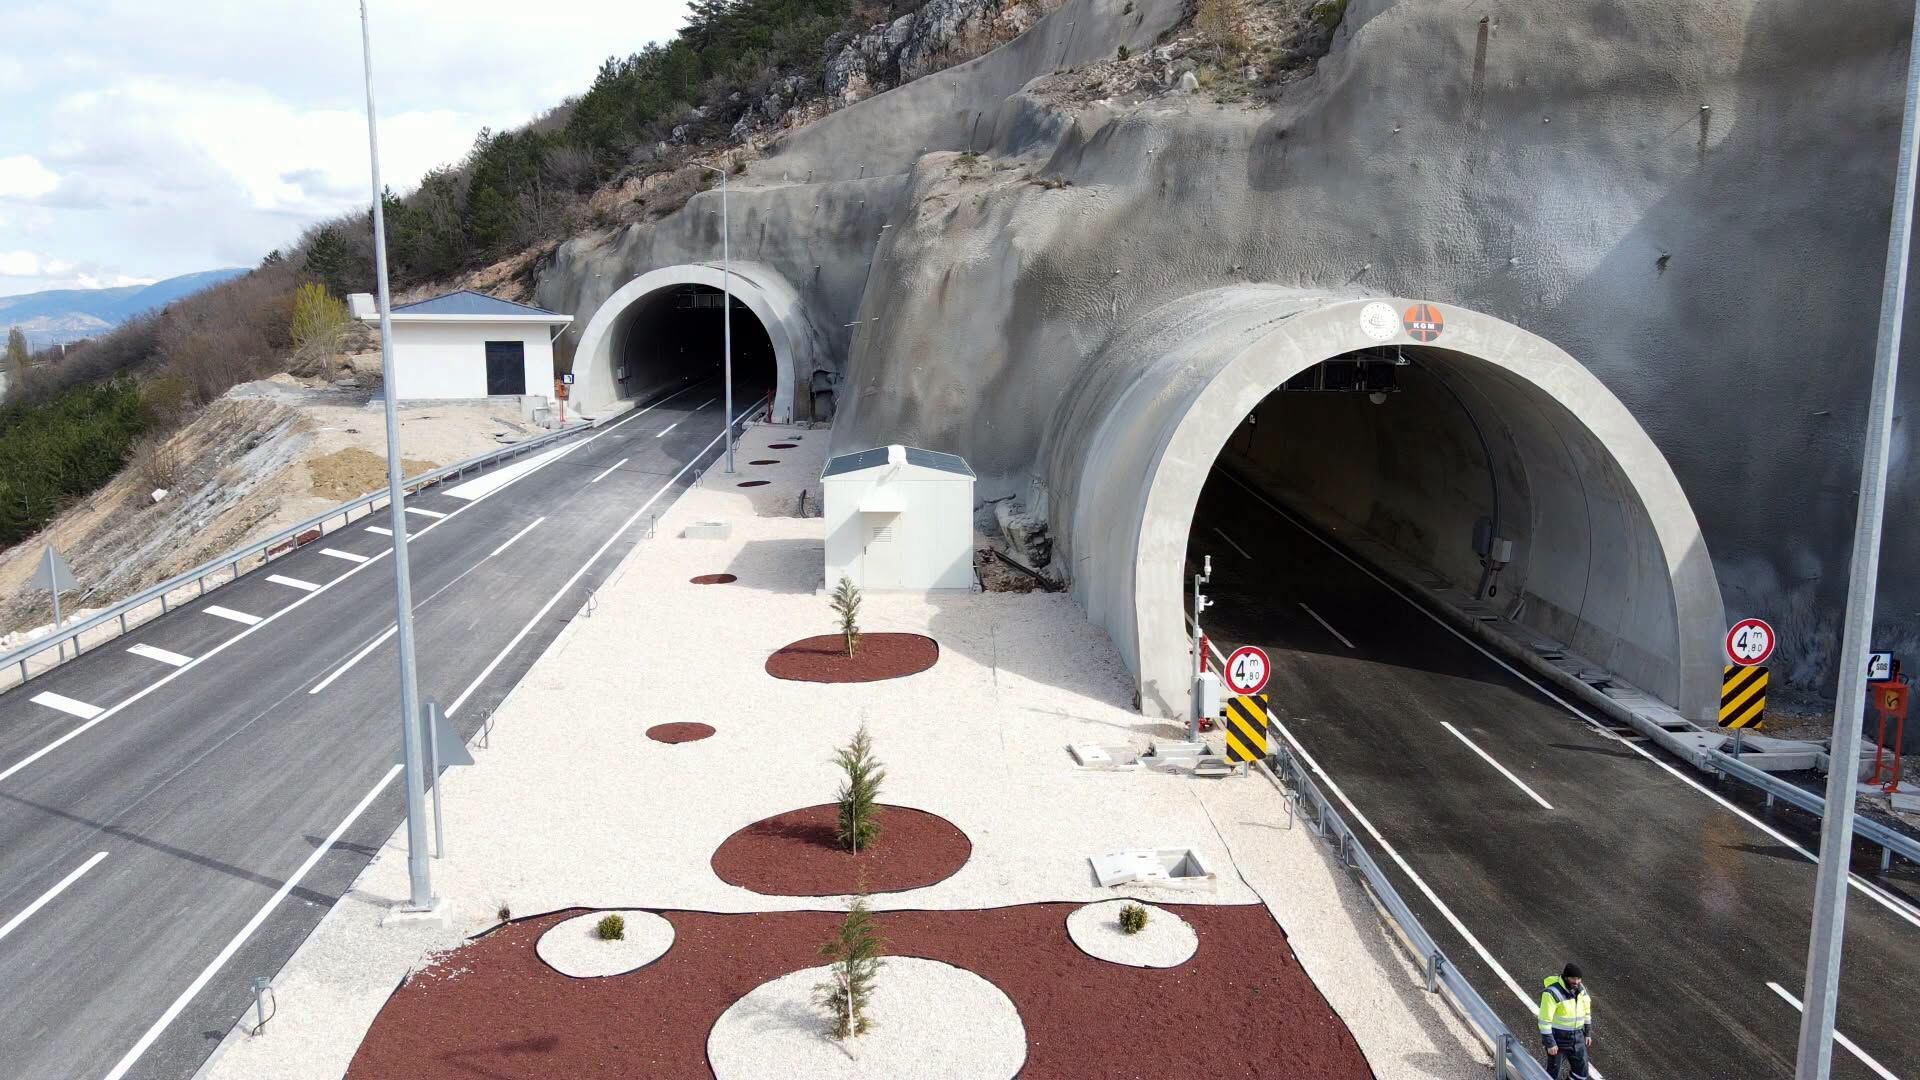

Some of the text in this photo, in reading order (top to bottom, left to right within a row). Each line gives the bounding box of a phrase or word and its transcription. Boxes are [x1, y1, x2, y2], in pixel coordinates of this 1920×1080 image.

[1413, 322, 1434, 330] KGM
[1737, 632, 1747, 651] 4
[1236, 660, 1246, 681] 4
[1876, 662, 1888, 671] SOS
